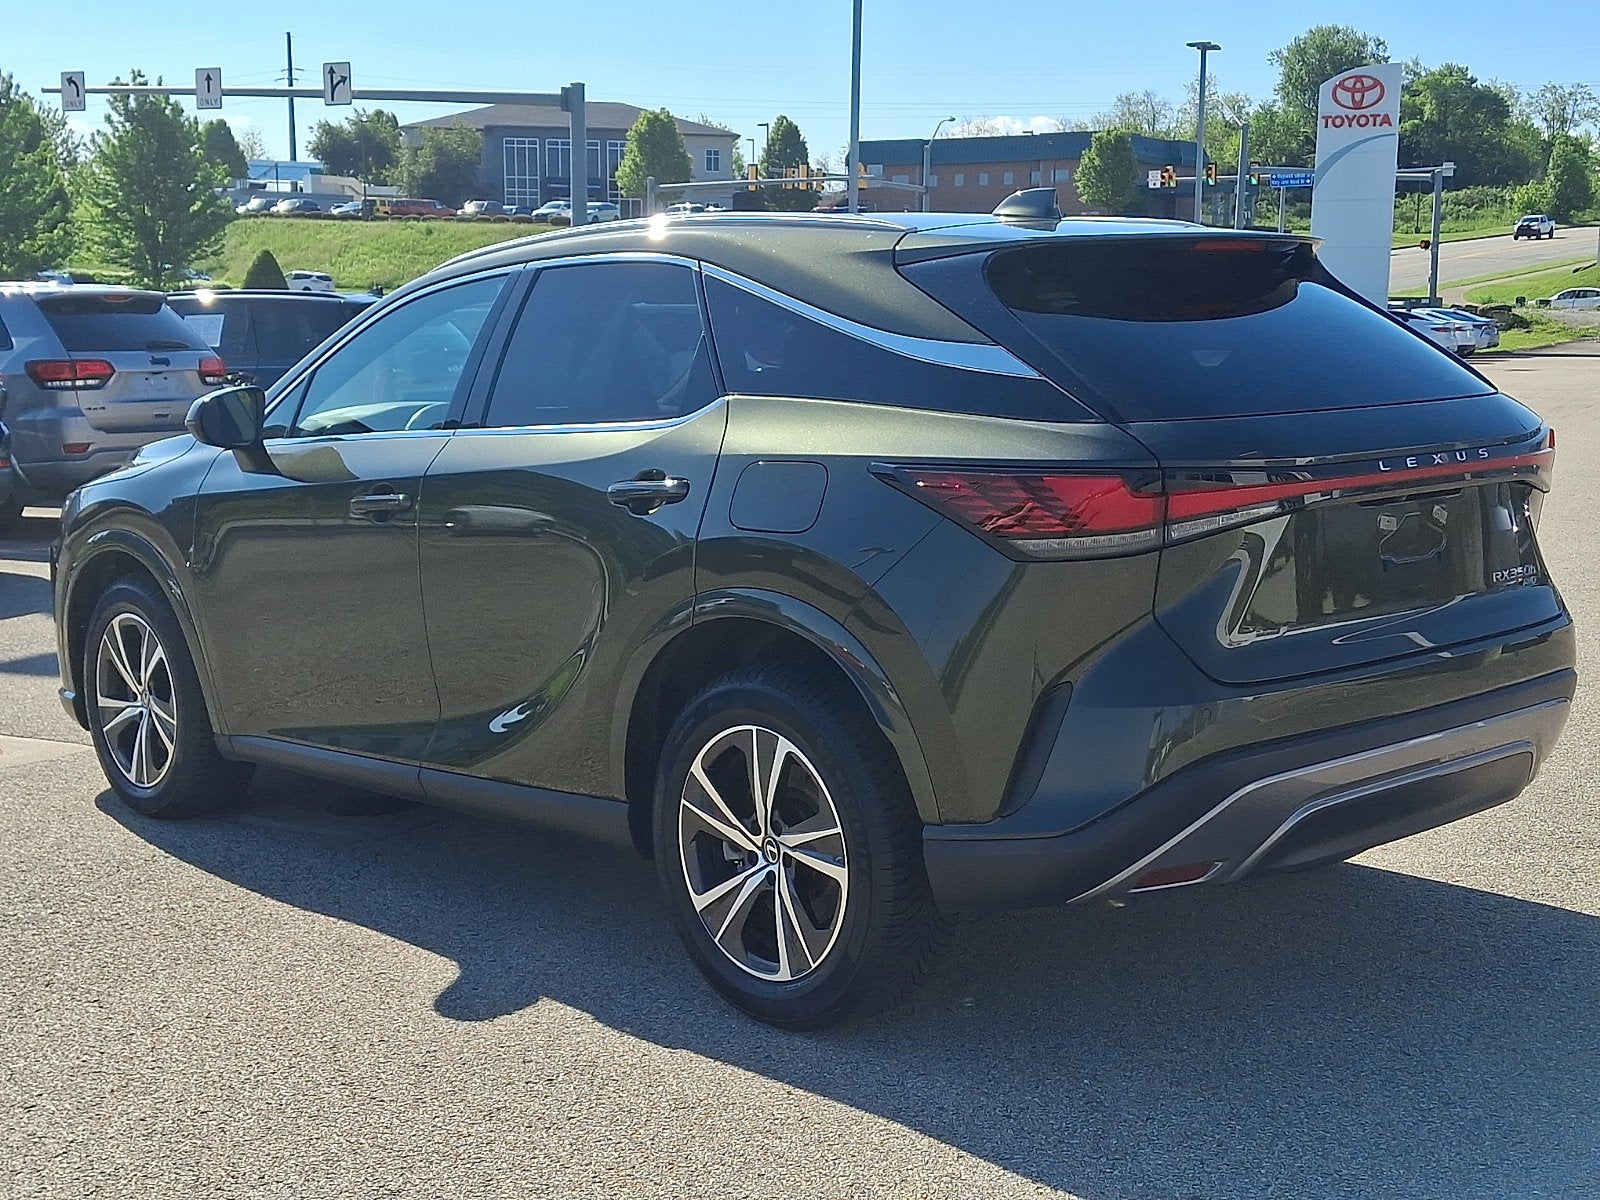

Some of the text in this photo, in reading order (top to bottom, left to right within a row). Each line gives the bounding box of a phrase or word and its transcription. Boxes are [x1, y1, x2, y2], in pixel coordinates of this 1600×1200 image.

[65, 100, 82, 108] ONLY
[200, 98, 218, 106] ONLY
[1321, 113, 1393, 129] TOYOTA
[1379, 448, 1489, 471] LEXUS
